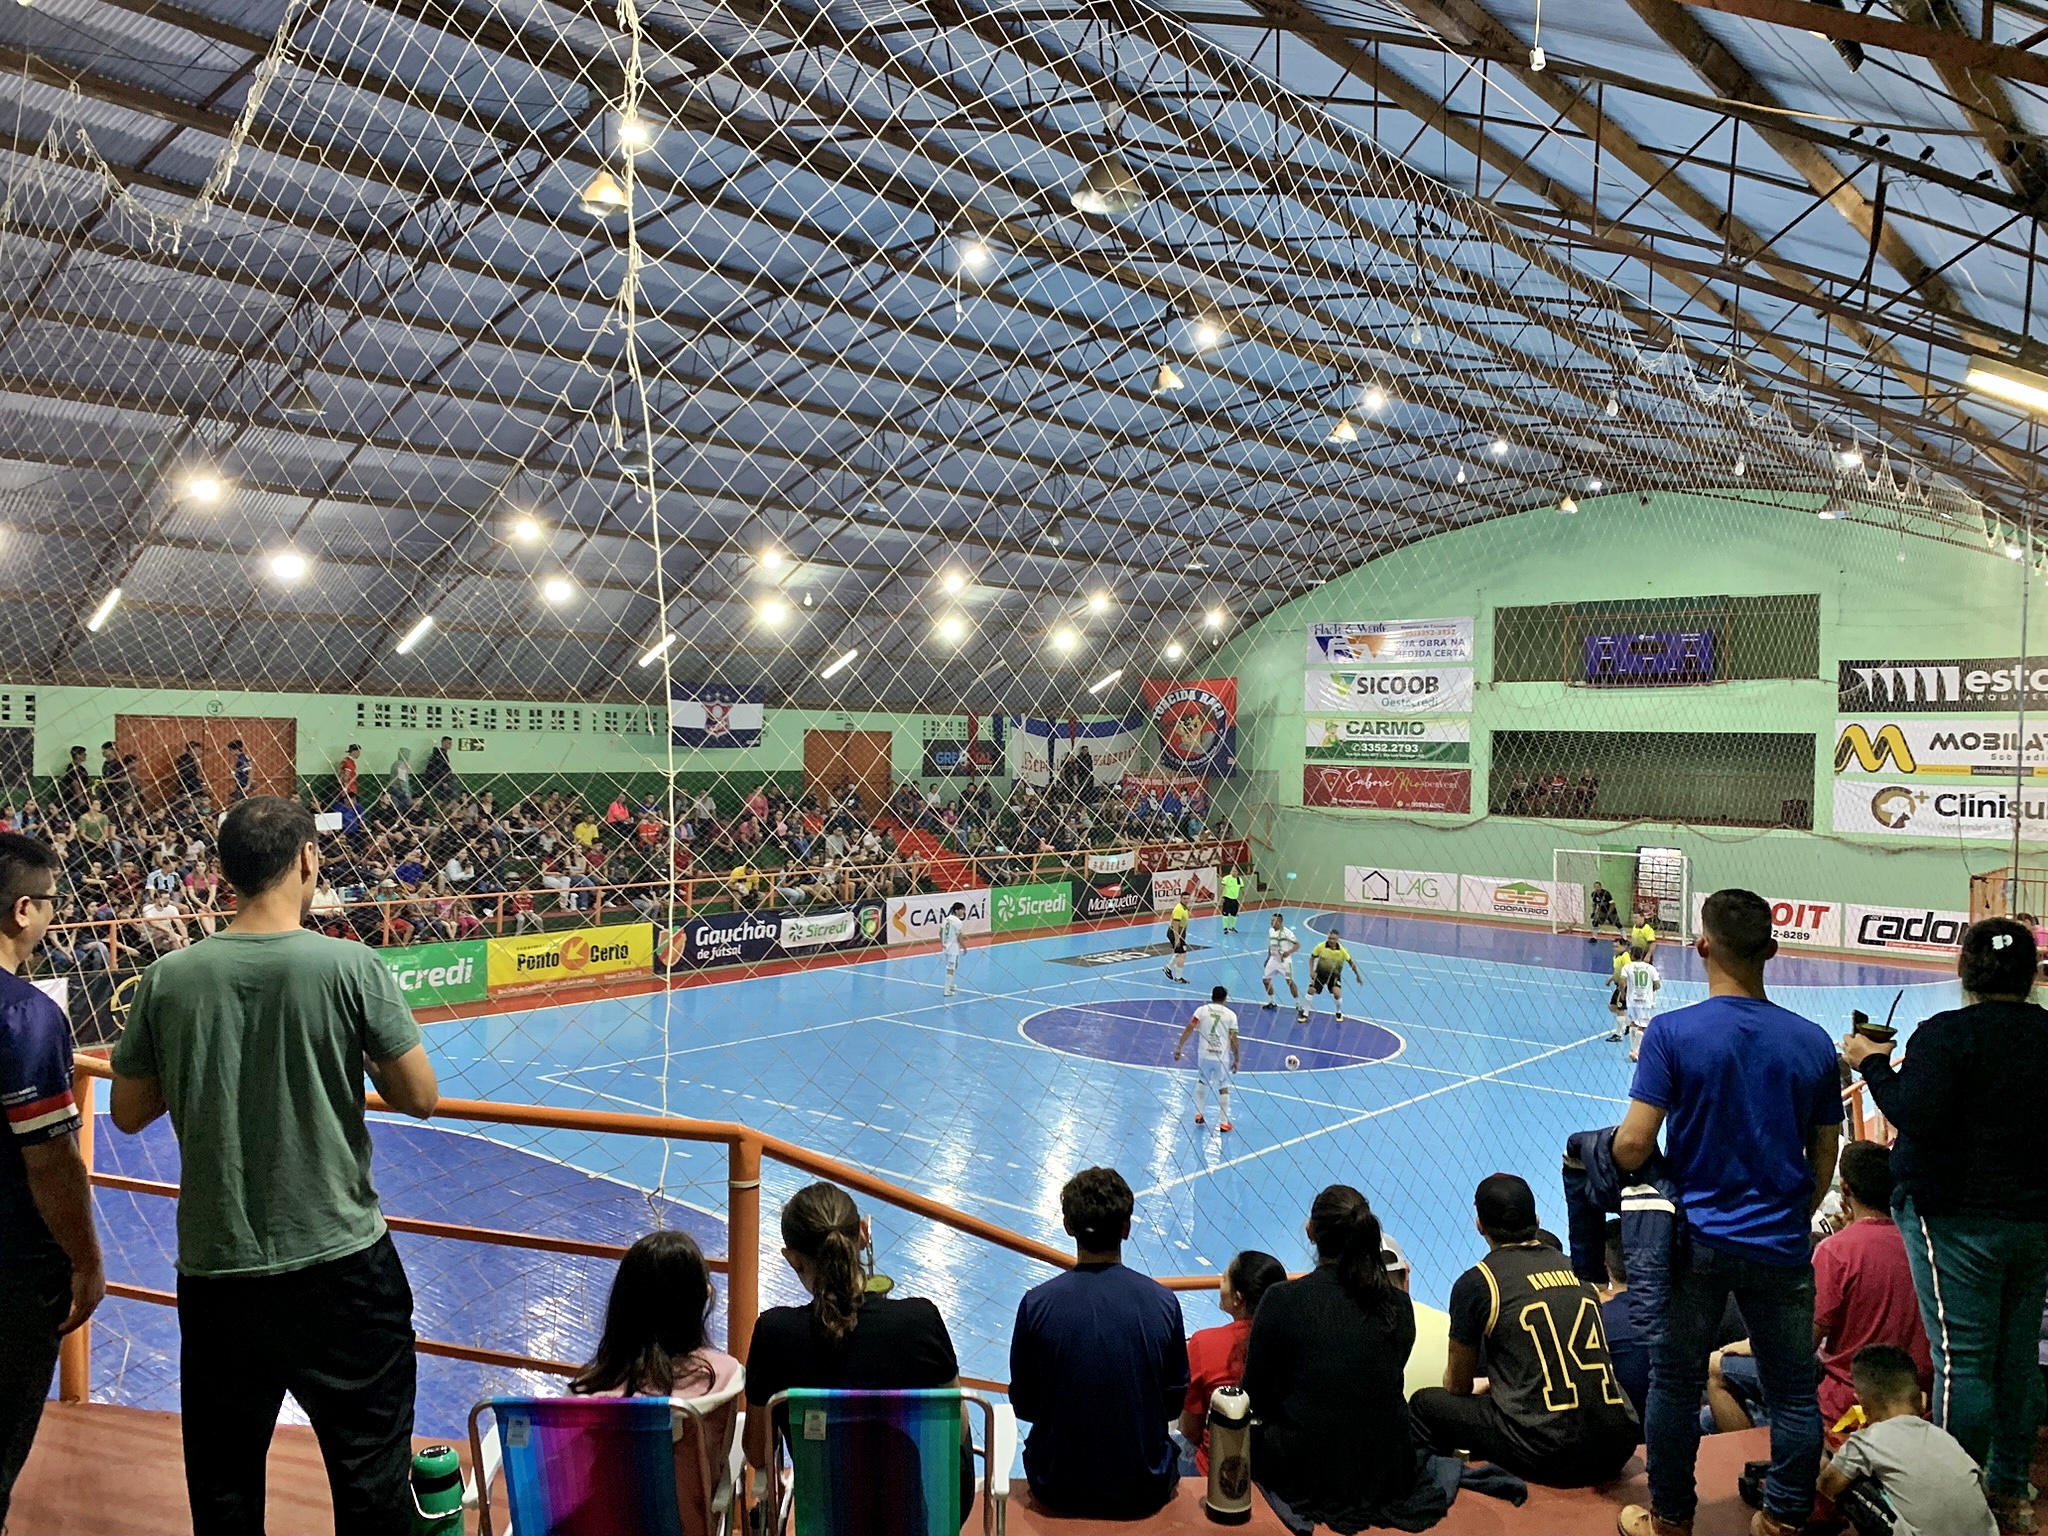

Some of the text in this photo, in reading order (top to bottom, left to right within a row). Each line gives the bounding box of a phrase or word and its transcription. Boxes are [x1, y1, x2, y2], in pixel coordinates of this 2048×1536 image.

[1418, 638, 1447, 647] OBRA
[1450, 638, 1465, 646] NA
[1435, 648, 1465, 657] CERTA
[1356, 676, 1439, 695] SICOOB
[1346, 721, 1425, 735] CARMO
[1361, 744, 1418, 753] 3352.2793
[1395, 876, 1438, 898] LAG
[910, 898, 986, 927] CAMAÍ
[1018, 894, 1066, 916] Sicredi
[1494, 904, 1549, 915] COOPATRIGO
[696, 920, 777, 946] Gauchão
[806, 920, 848, 938] Sicredi
[517, 944, 629, 971] Ponto Certo
[697, 944, 742, 960] de futsal
[387, 957, 473, 991] icredi
[1633, 971, 1649, 986] 10
[1210, 1013, 1221, 1034] 7
[1519, 1297, 1624, 1412] 14
